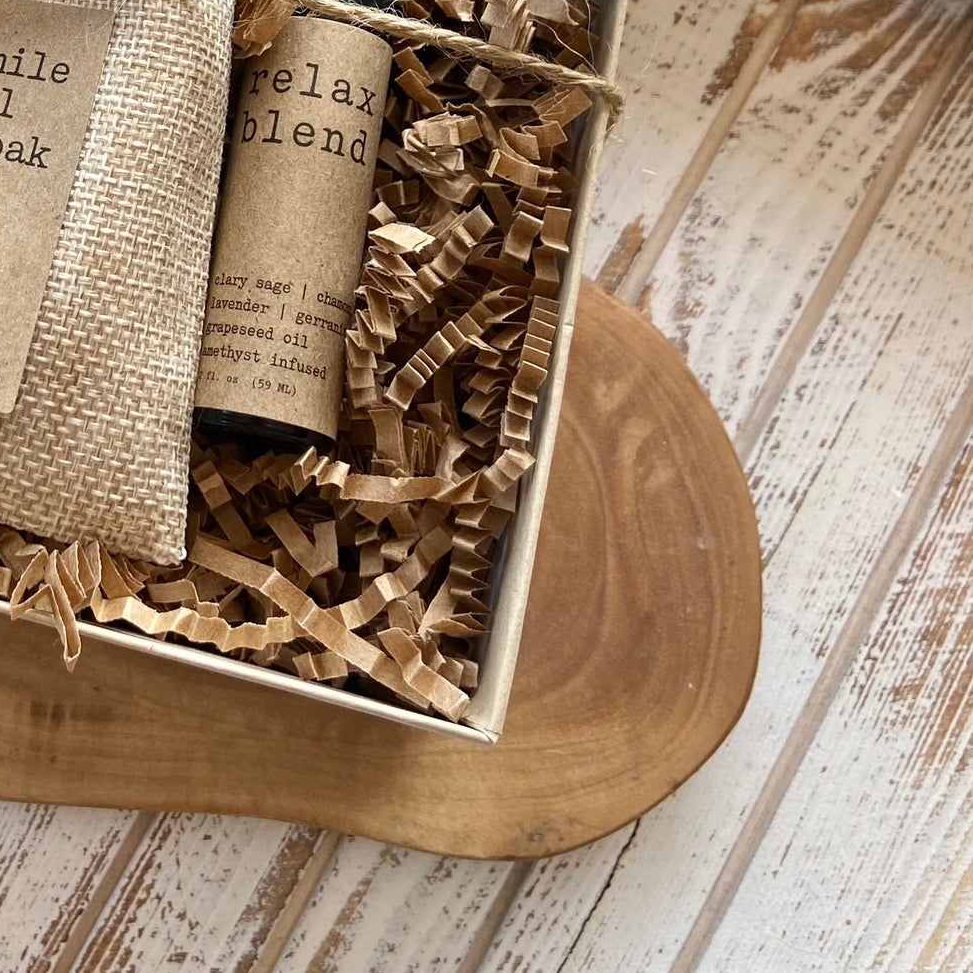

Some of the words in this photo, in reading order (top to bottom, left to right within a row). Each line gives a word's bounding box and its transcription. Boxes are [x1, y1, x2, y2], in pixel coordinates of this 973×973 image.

[249, 62, 376, 116] relax
[241, 109, 367, 166] blend
[214, 273, 248, 289] clary
[256, 278, 291, 295] sage
[210, 297, 269, 314] lavender
[205, 322, 274, 340] grapeseed
[283, 333, 308, 349] oil
[201, 344, 260, 363] amethyst
[270, 353, 327, 380] infused
